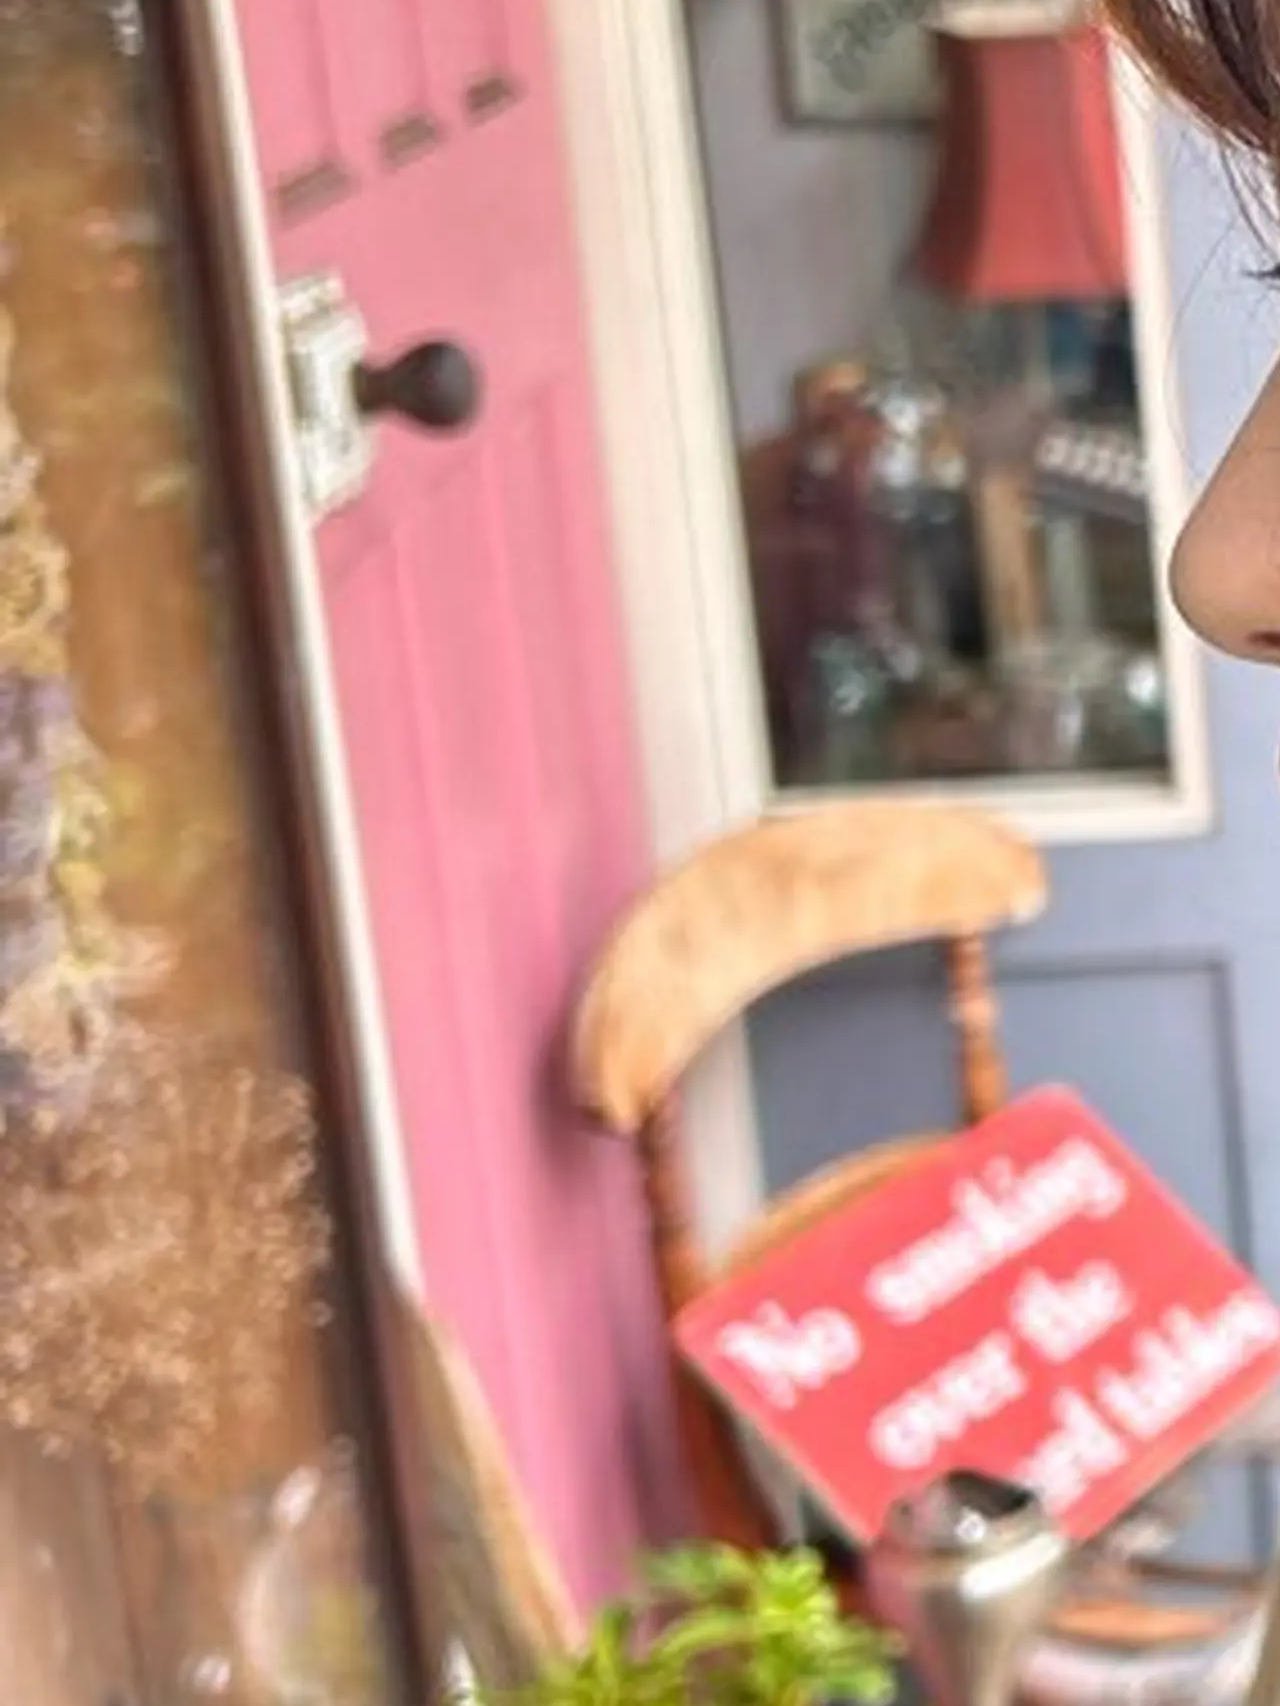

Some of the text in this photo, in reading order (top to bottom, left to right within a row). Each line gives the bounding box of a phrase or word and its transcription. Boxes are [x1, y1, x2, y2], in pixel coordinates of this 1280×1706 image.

[714, 1135, 1128, 1410] No smoking
[869, 1259, 1134, 1471] over the
